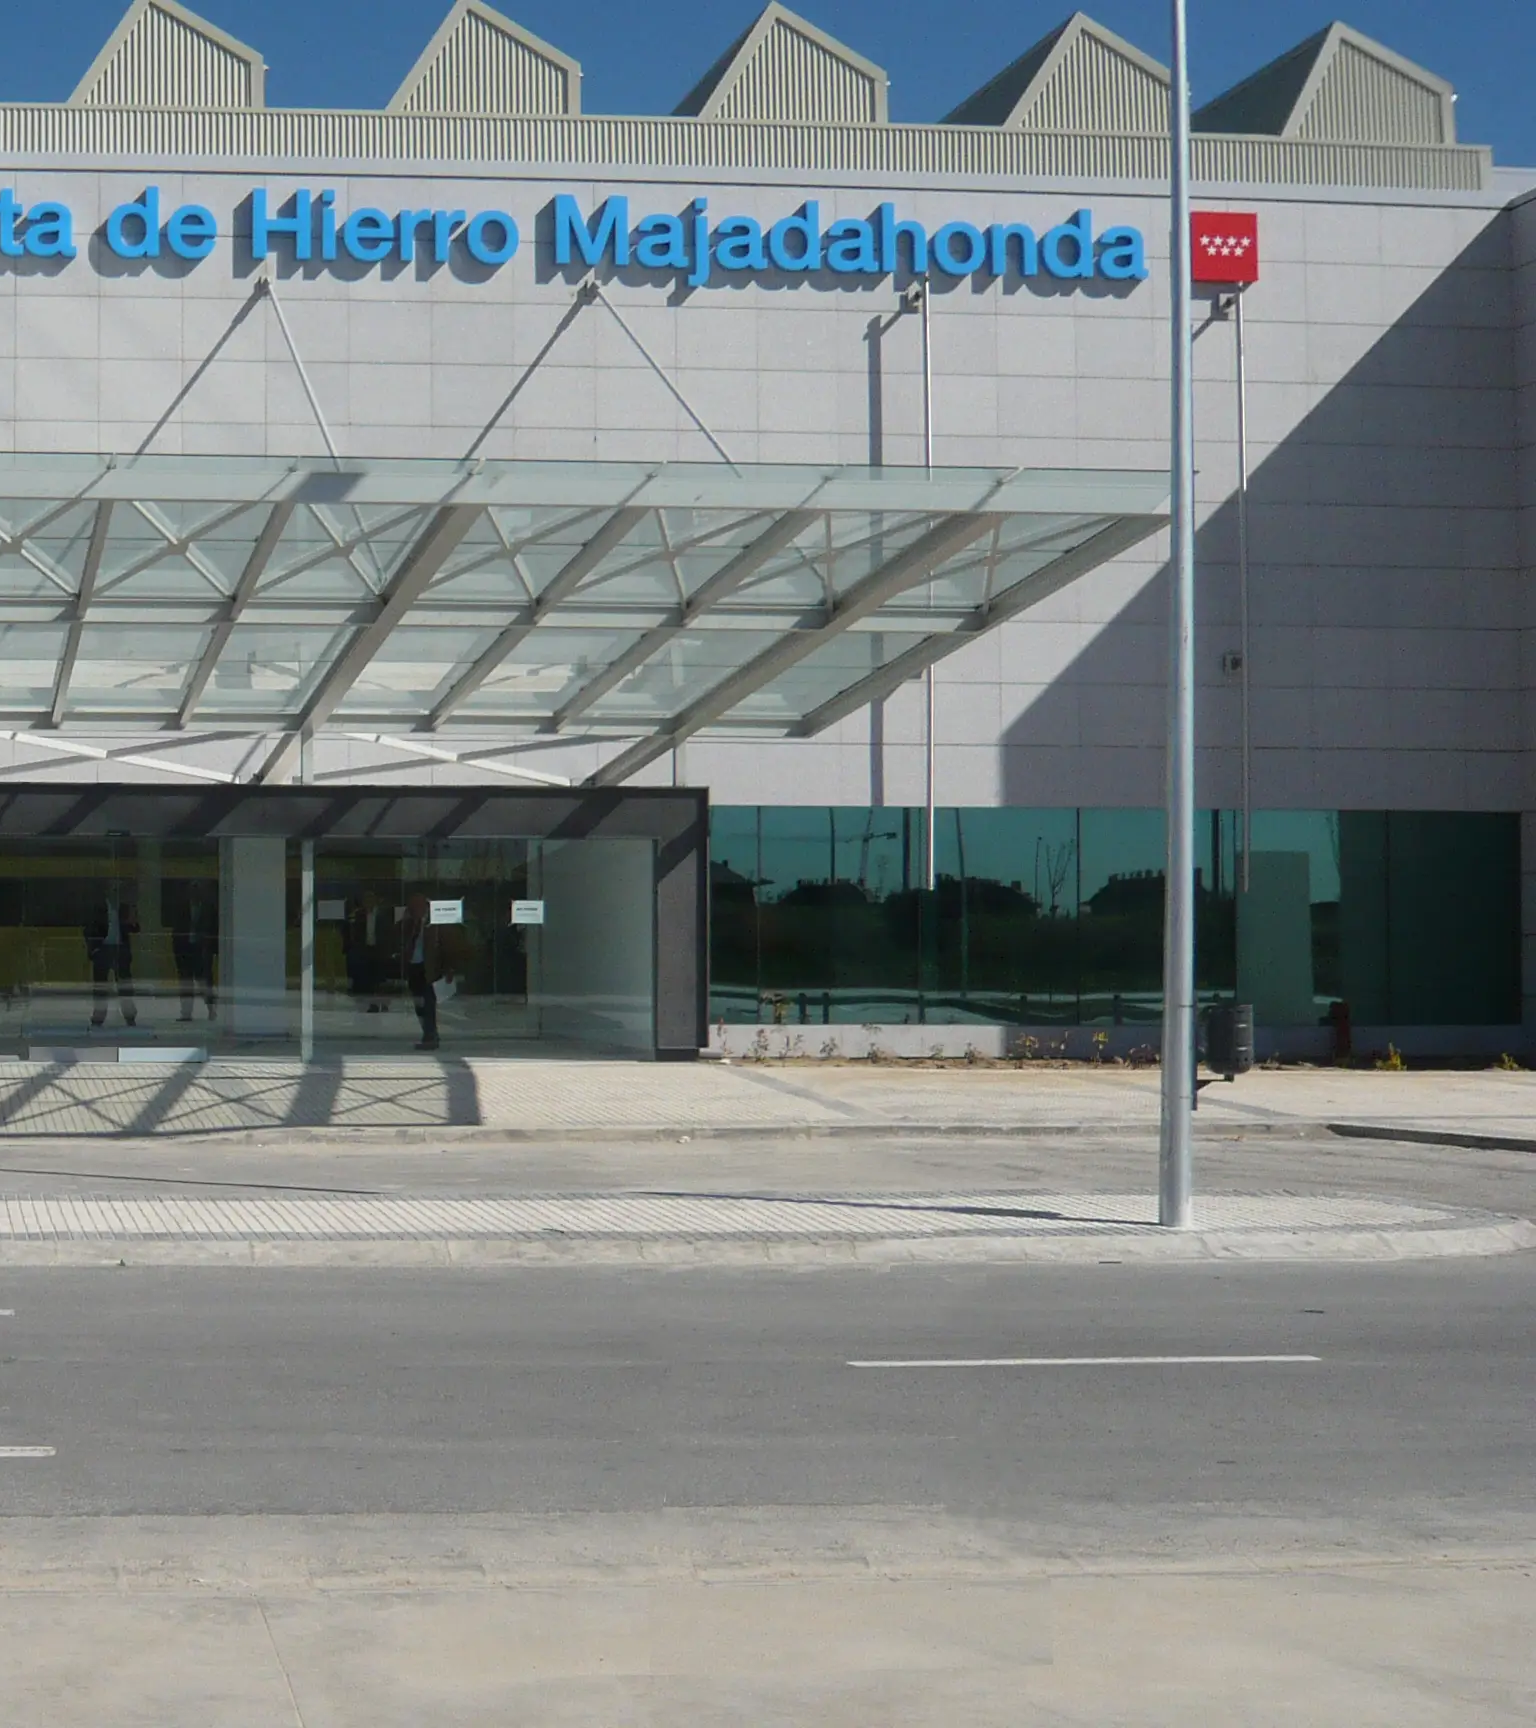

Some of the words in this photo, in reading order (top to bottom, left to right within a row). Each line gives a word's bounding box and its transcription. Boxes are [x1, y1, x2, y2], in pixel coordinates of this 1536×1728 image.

[107, 186, 218, 261] de
[252, 187, 520, 266] Hierro
[555, 194, 1150, 288] Majadahonda
